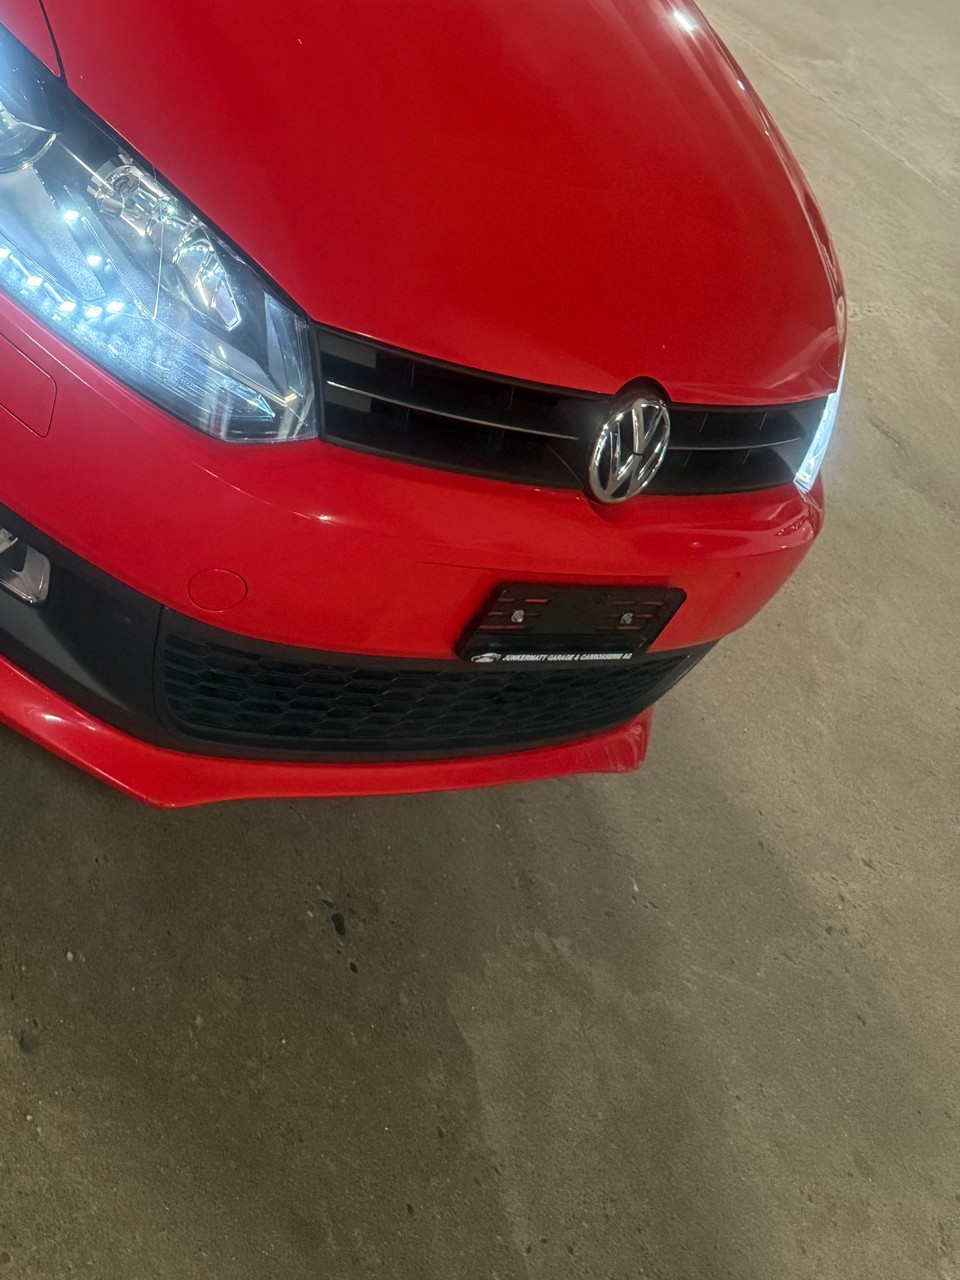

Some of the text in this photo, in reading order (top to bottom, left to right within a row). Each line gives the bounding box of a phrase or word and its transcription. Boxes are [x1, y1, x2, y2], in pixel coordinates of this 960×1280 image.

[547, 654, 574, 662] GARAGE
[580, 653, 623, 661] CARROSSERIE
[621, 652, 633, 660] AG
